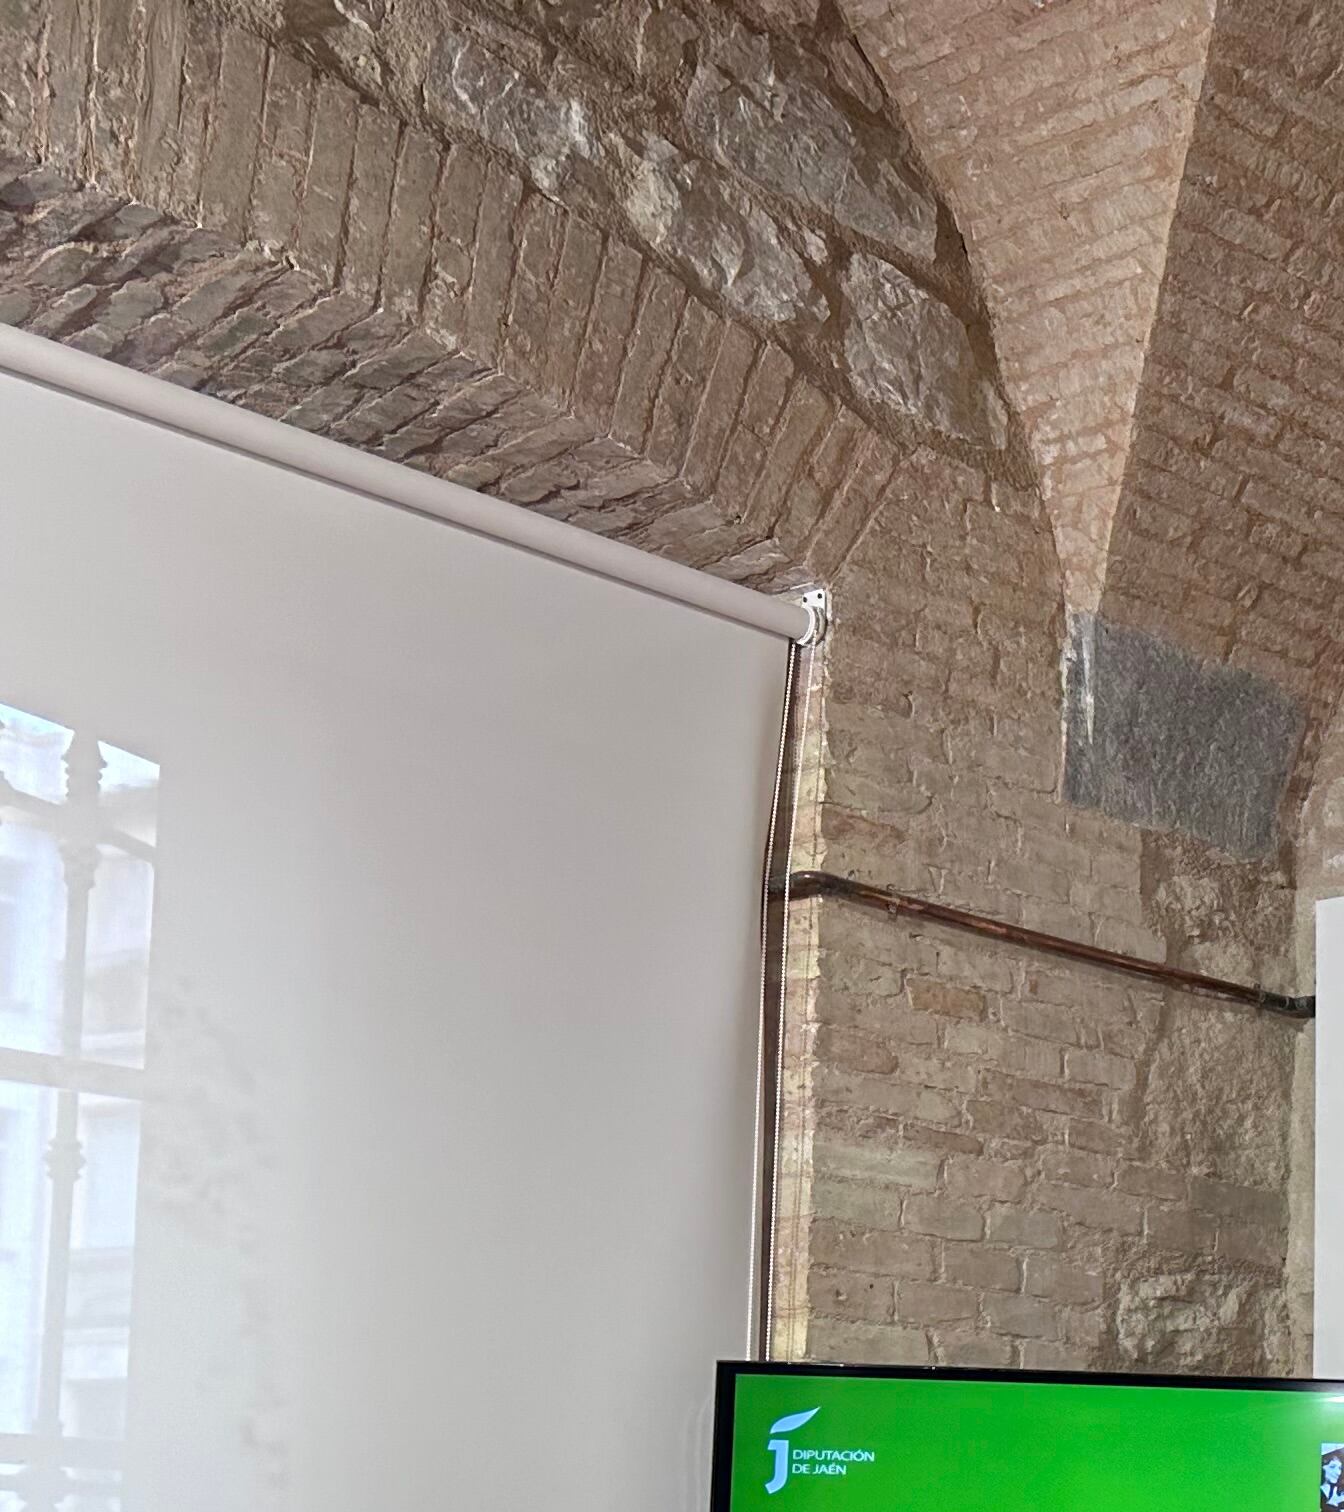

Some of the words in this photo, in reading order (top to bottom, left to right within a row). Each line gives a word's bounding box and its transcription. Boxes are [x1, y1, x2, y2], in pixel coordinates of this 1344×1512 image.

[792, 1447, 875, 1462] DIPUTACIÓN
[792, 1463, 811, 1474] DE
[812, 1462, 847, 1475] JAÉN
